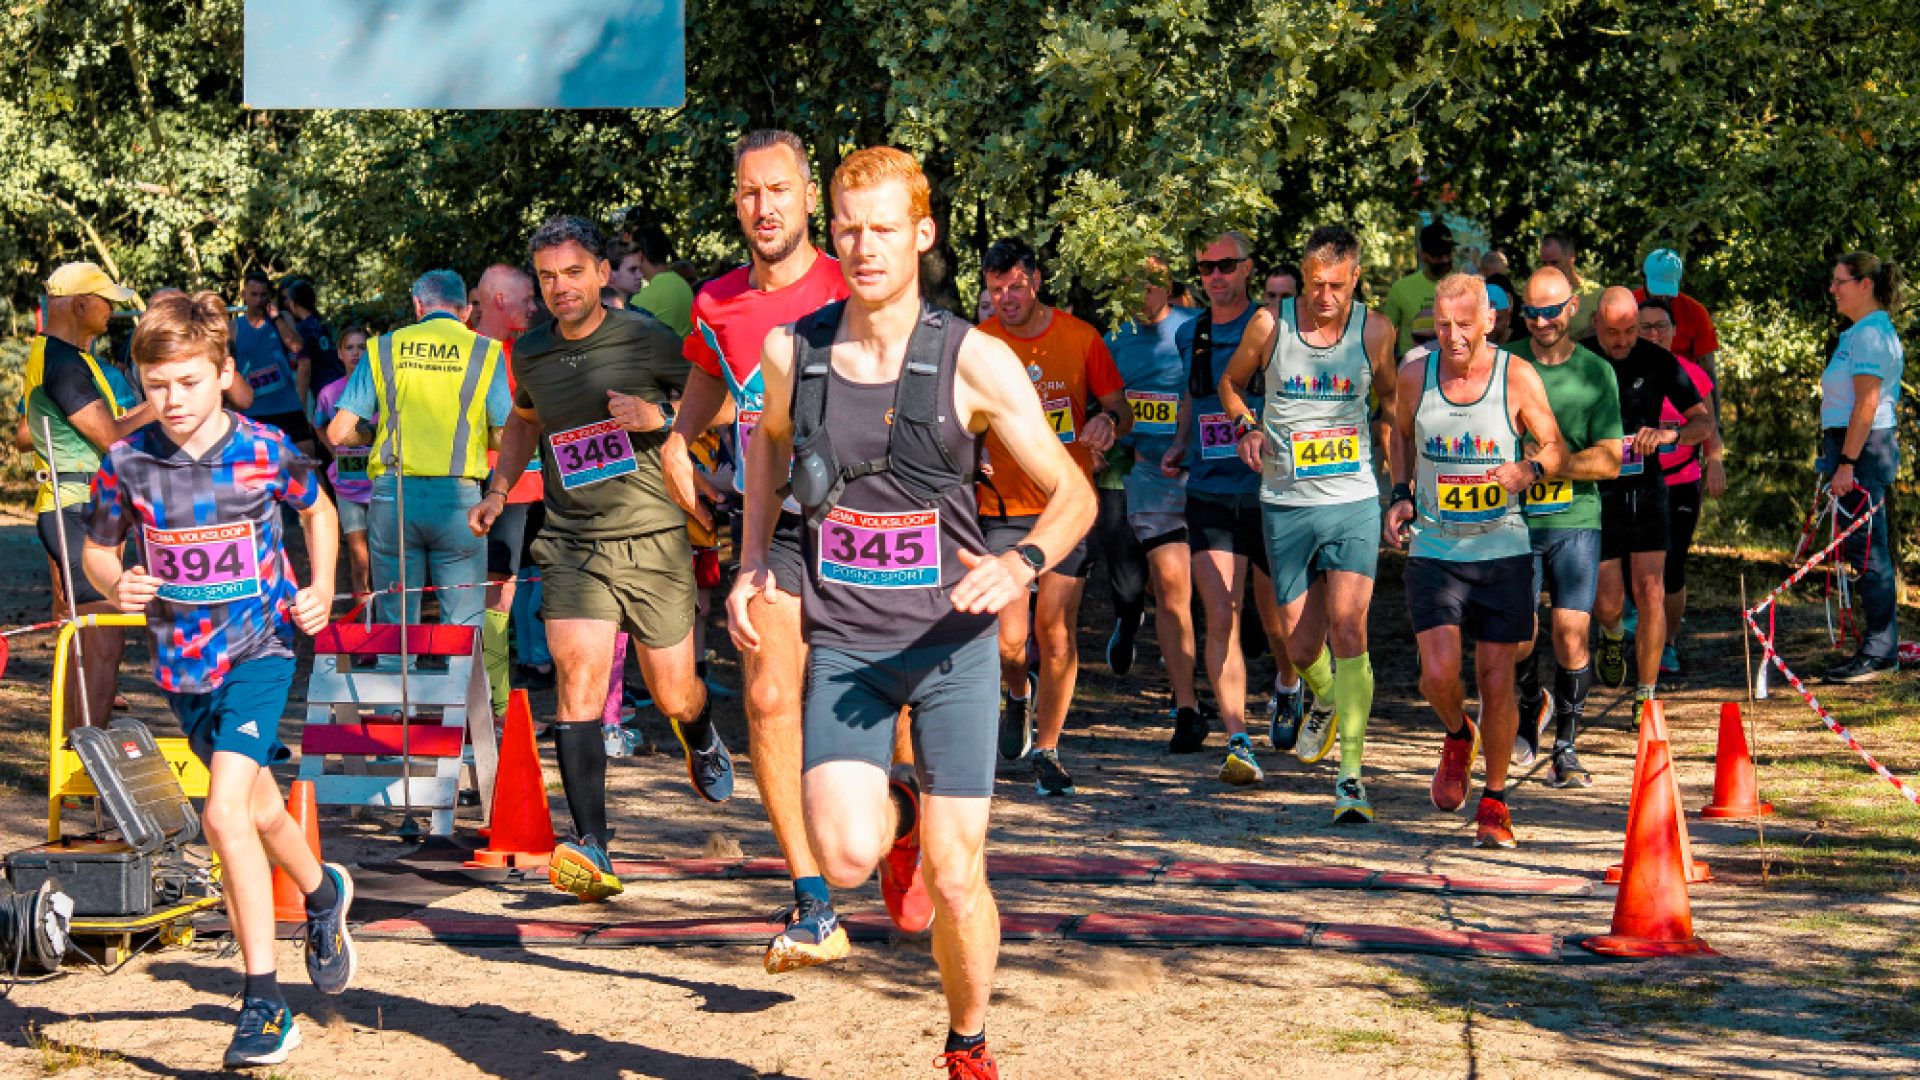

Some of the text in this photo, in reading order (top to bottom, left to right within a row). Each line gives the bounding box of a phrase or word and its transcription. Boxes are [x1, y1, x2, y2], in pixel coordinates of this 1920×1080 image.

[400, 341, 460, 359] HEMA
[1133, 401, 1170, 420] 408
[1205, 424, 1234, 446] 33
[563, 434, 624, 471] 346
[1301, 438, 1354, 463] 446
[1445, 485, 1501, 509] 410
[1529, 481, 1565, 501] 07
[860, 514, 933, 527] VOLKSLOOP
[179, 527, 244, 542] VOLKSLOOP
[831, 526, 924, 567] 345
[154, 542, 245, 582] 394
